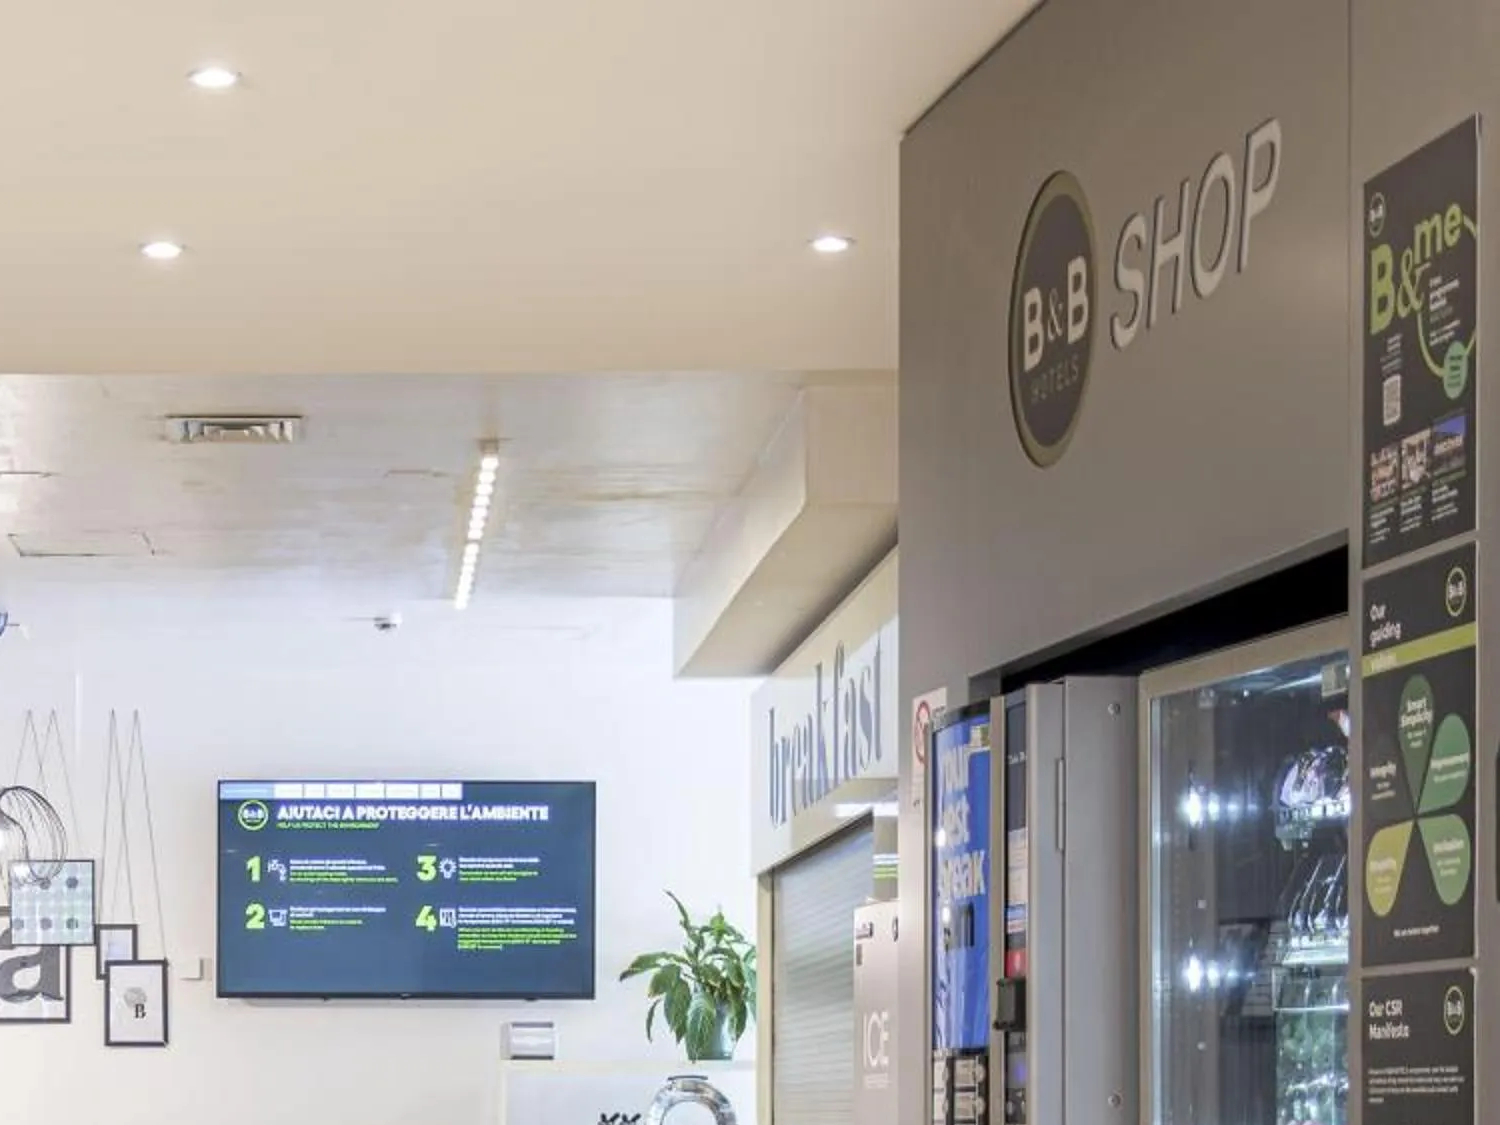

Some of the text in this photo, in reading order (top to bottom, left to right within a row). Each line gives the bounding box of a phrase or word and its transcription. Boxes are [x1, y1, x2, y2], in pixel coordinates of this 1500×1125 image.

[1110, 116, 1282, 351] SHOP
[1369, 603, 1387, 623] Our
[768, 629, 883, 829] breakfast
[277, 803, 549, 820] AIUTACI A PROTEGGERE L'AMBIENTE
[246, 855, 261, 882] 1
[416, 855, 437, 881] 3
[245, 903, 265, 929] 2
[415, 905, 437, 932] 4
[133, 1002, 146, 1020] B
[1368, 1000, 1385, 1018] Our
[1368, 1022, 1410, 1040] Manifesto
